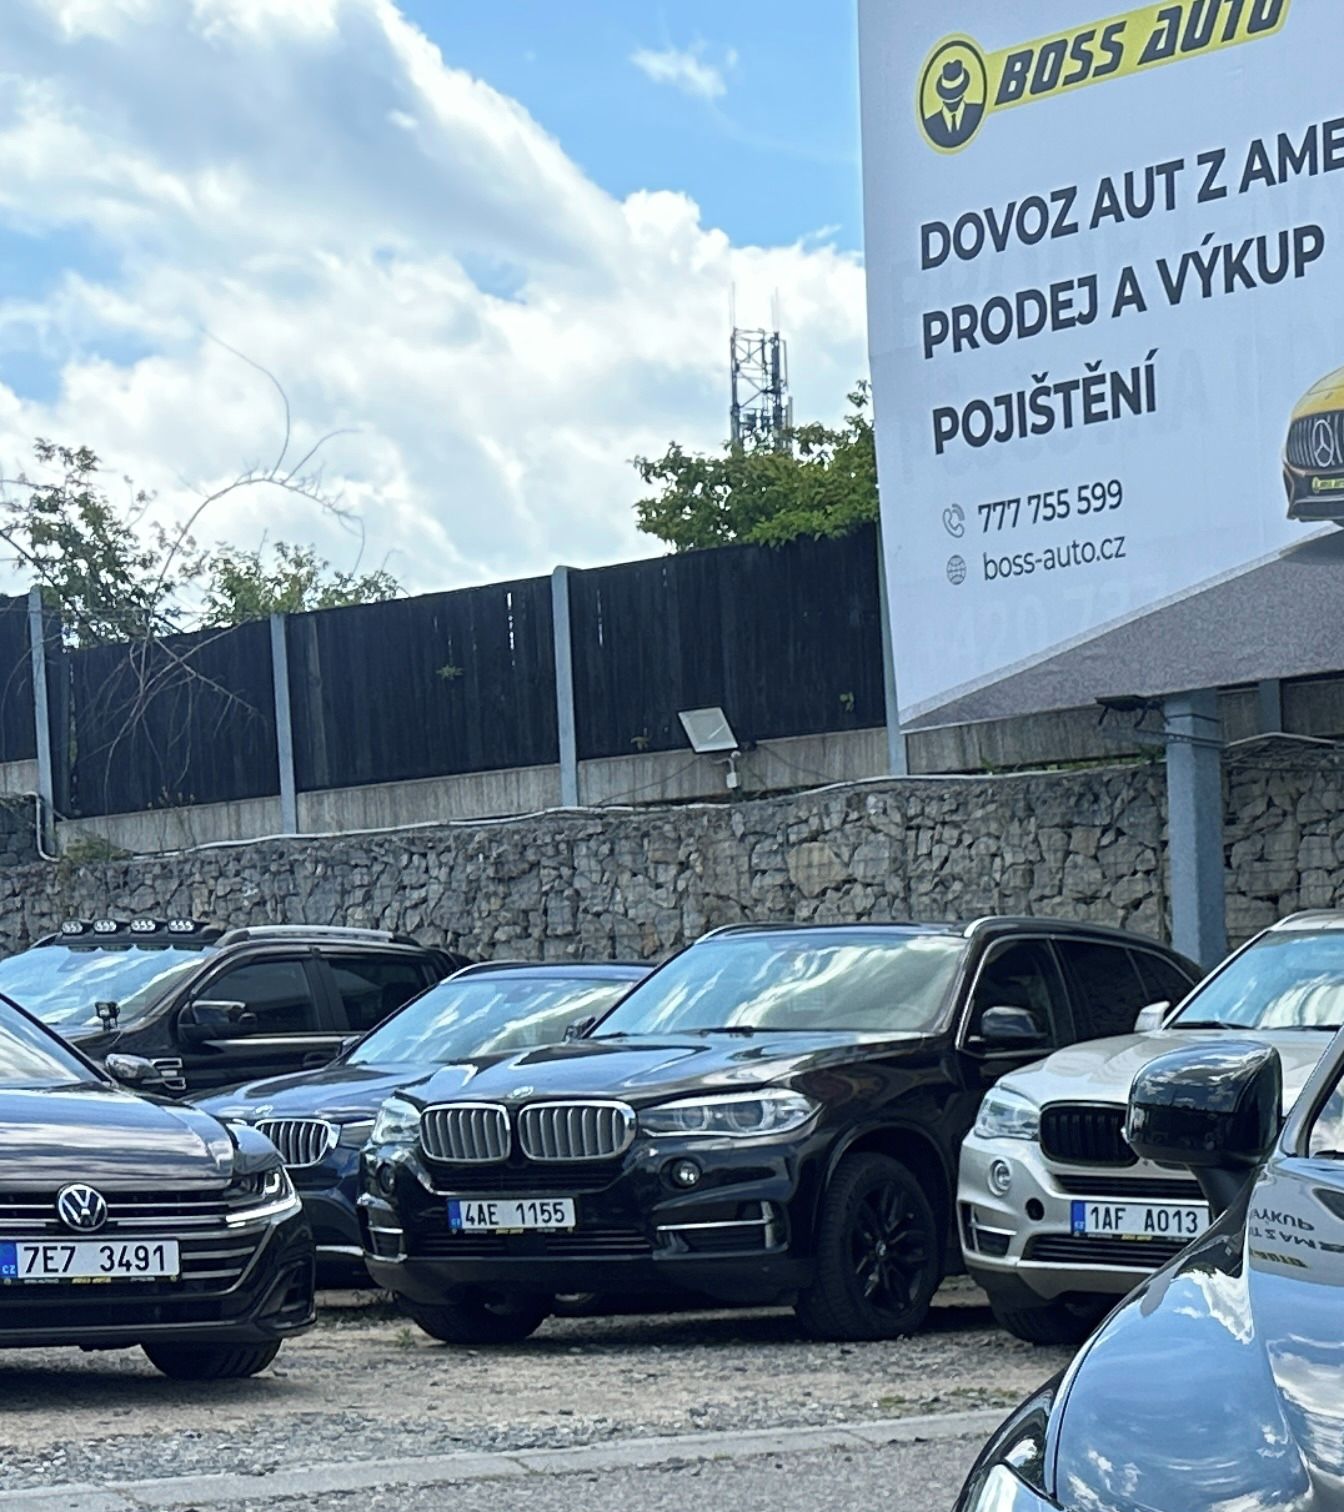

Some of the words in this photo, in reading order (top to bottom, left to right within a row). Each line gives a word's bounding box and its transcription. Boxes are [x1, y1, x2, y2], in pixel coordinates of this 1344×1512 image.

[993, 20, 1128, 106] BOSS
[1137, 0, 1284, 66] AUTO
[921, 185, 1079, 270] DOVOZ
[1089, 158, 1185, 230] AUT
[1197, 148, 1227, 204] Z
[922, 273, 1098, 360] PRODEJ
[1111, 265, 1148, 319] A
[1156, 224, 1325, 306] VÝKUP
[932, 347, 1160, 455] POJIŠTĚNÍ
[977, 497, 1022, 533] 777
[1027, 488, 1071, 525] 755
[1076, 479, 1123, 515] 599
[982, 535, 1127, 582] boss-auto.cz
[465, 1203, 499, 1226] 4AE
[515, 1201, 565, 1225] 1155
[1090, 1205, 1127, 1231] 1AF
[2, 1265, 16, 1274] CZ
[23, 1245, 76, 1274] 7E7
[99, 1244, 165, 1273] 3491
